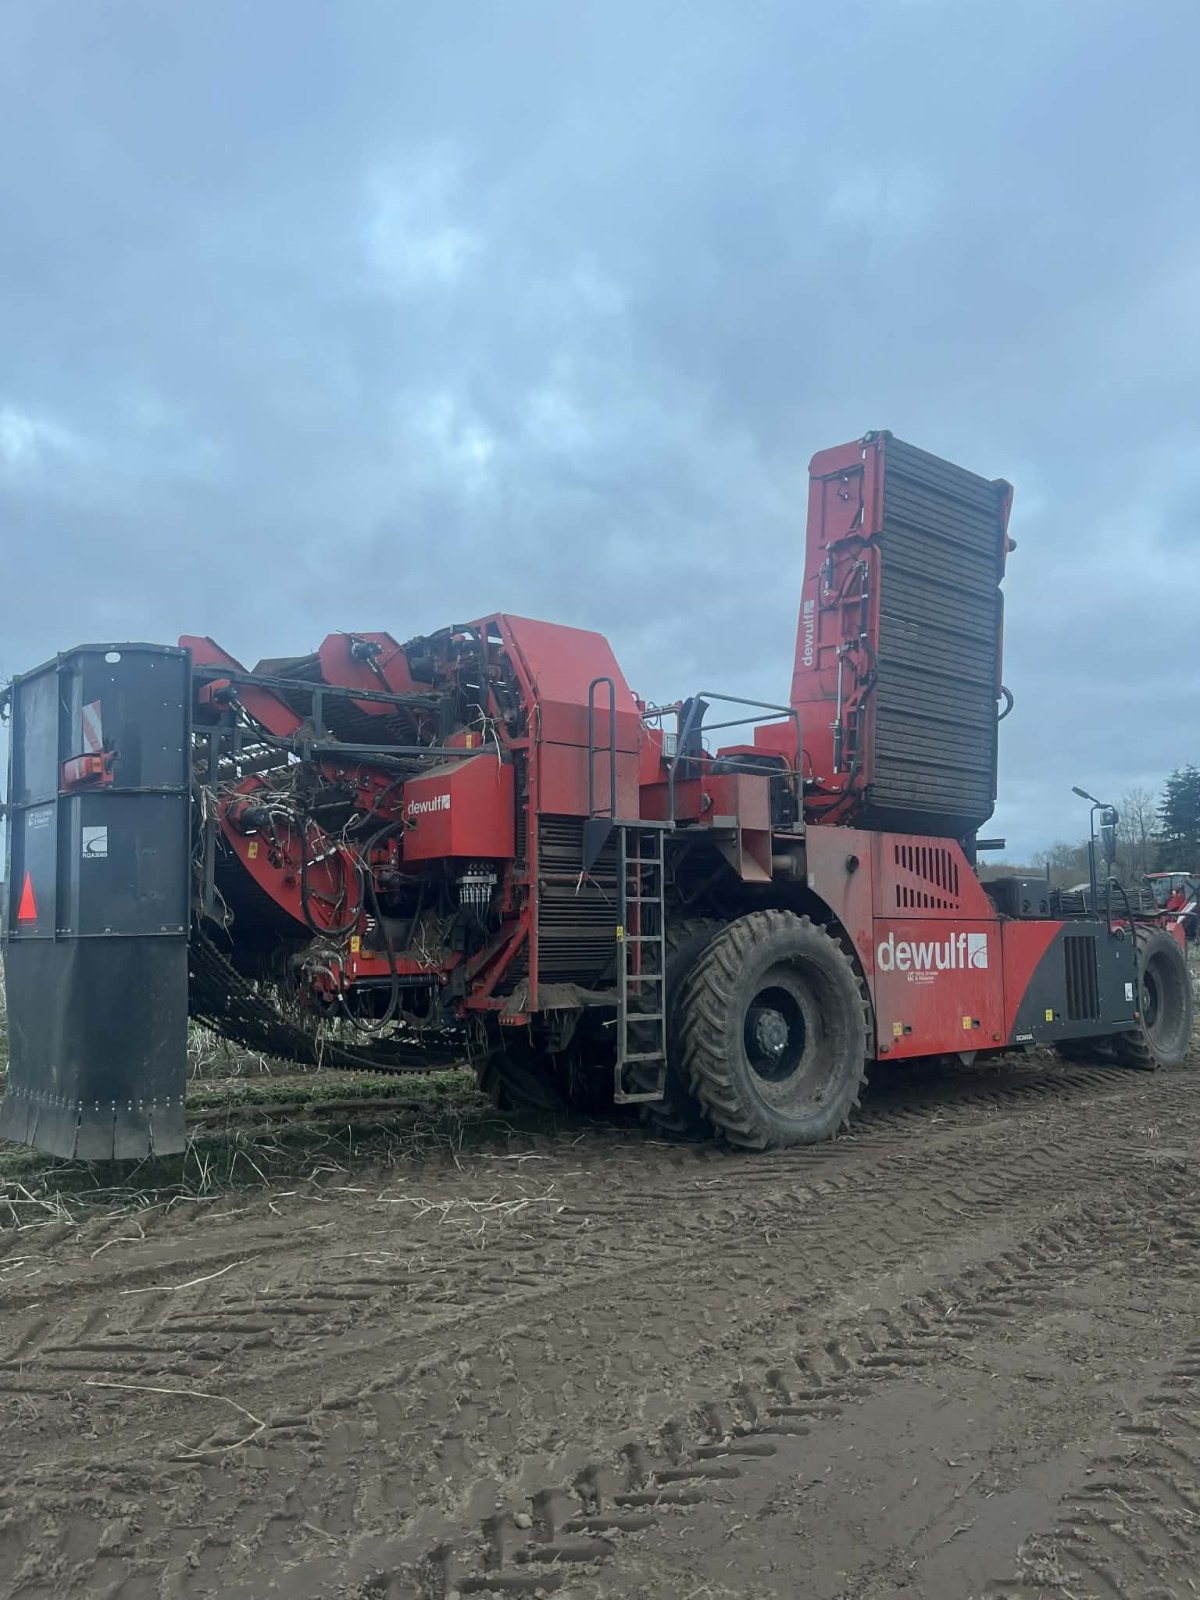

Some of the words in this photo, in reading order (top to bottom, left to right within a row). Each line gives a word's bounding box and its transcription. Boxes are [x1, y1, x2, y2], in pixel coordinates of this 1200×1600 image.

[802, 612, 813, 666] dewulf
[408, 796, 442, 815] dewulf
[877, 931, 967, 971] dewulf
